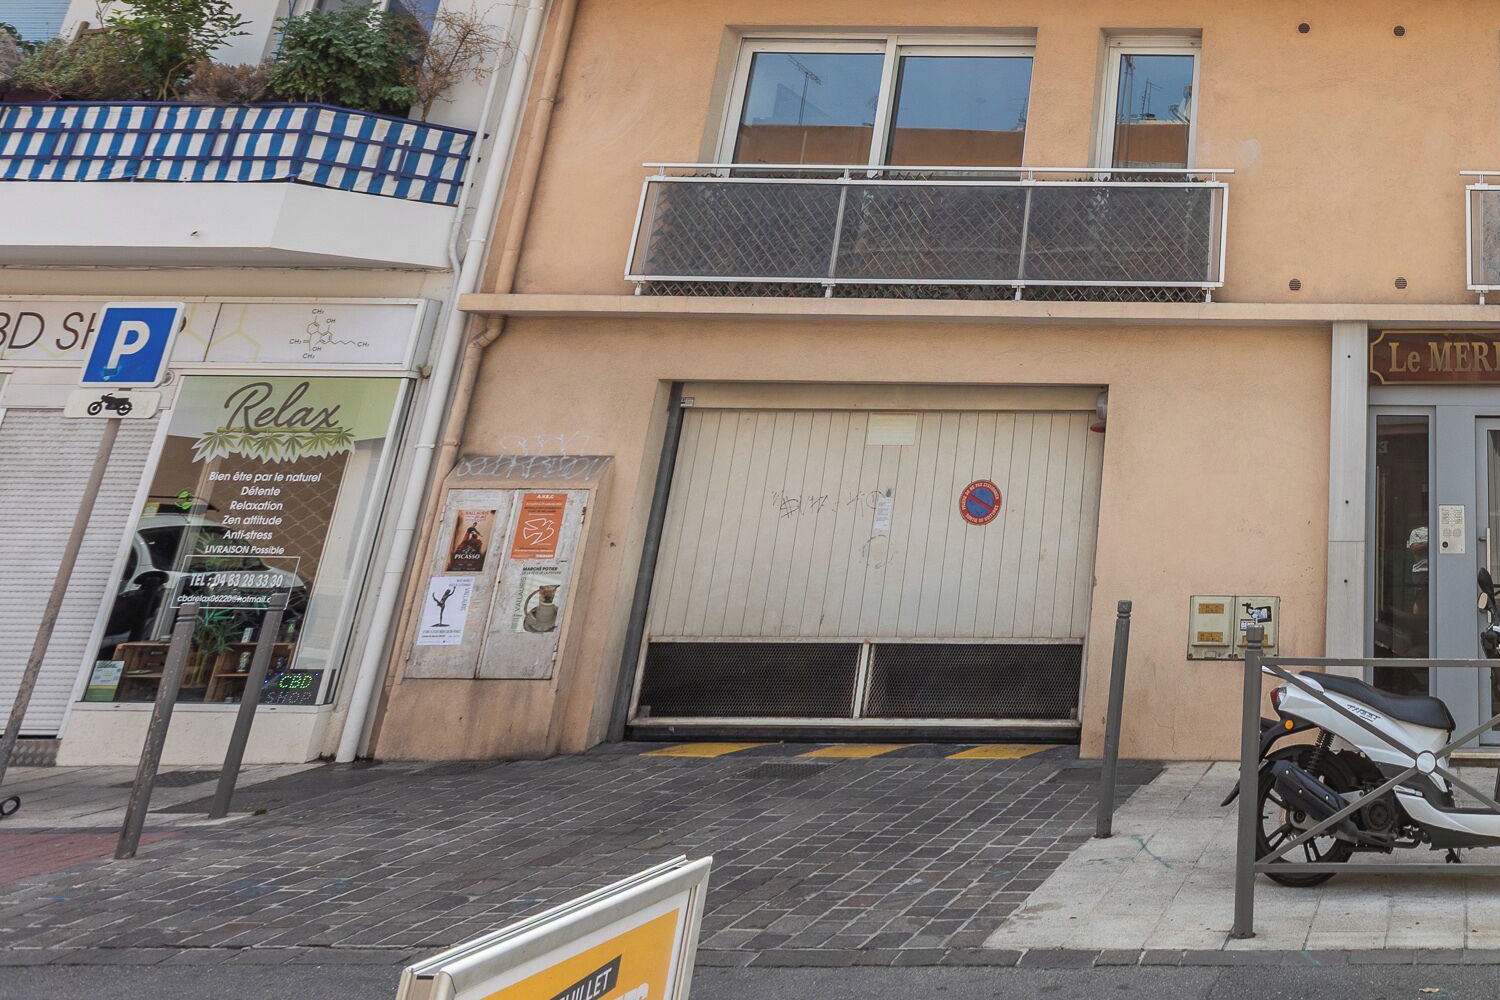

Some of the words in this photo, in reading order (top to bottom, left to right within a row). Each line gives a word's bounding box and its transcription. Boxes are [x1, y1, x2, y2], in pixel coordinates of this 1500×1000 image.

[107, 320, 150, 369] P
[1389, 342, 1420, 372] Le
[224, 382, 341, 435] Relax
[209, 471, 231, 481] Bien
[232, 472, 253, 481] être
[254, 473, 272, 482] par
[274, 472, 284, 481] le
[286, 472, 322, 482] naturel
[240, 486, 281, 496] Détente
[229, 500, 284, 511] Relaxation
[222, 515, 241, 525] Zen
[242, 515, 283, 526] attitude
[222, 530, 273, 540] Anti-stress
[204, 545, 249, 554] LIVRAISON
[250, 546, 285, 555] Possible
[227, 573, 241, 587] 83
[242, 573, 255, 587] 28
[255, 574, 269, 587] 33
[270, 575, 284, 588] 30
[279, 675, 313, 689] CBD
[265, 691, 312, 704] SHOP
